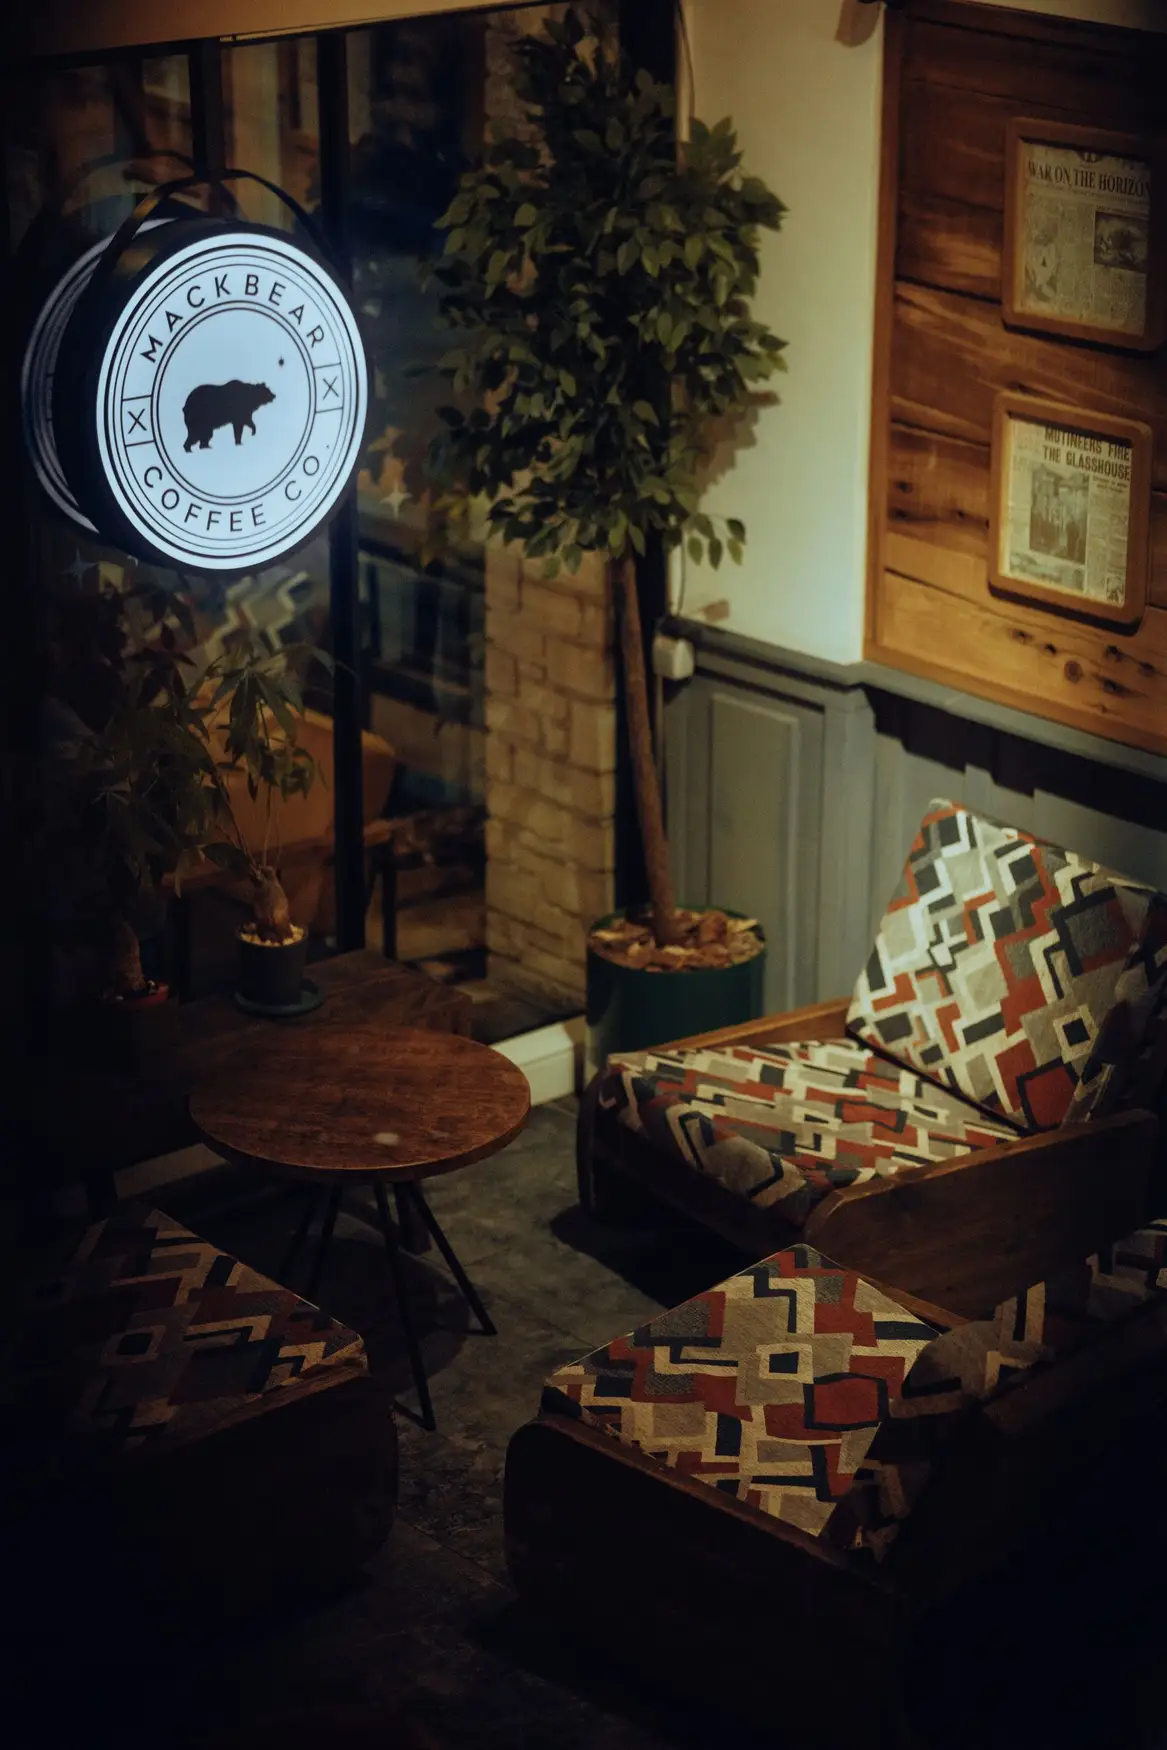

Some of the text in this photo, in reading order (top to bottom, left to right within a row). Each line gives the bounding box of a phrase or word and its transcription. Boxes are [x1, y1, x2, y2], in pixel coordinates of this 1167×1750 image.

[1028, 160, 1053, 181] WAR
[1054, 166, 1072, 187] ON
[1073, 168, 1096, 189] THE
[140, 273, 325, 363] MACKBEAR
[1043, 445, 1131, 481] THE GLASSHOUSE
[144, 465, 266, 532] COFFEE
